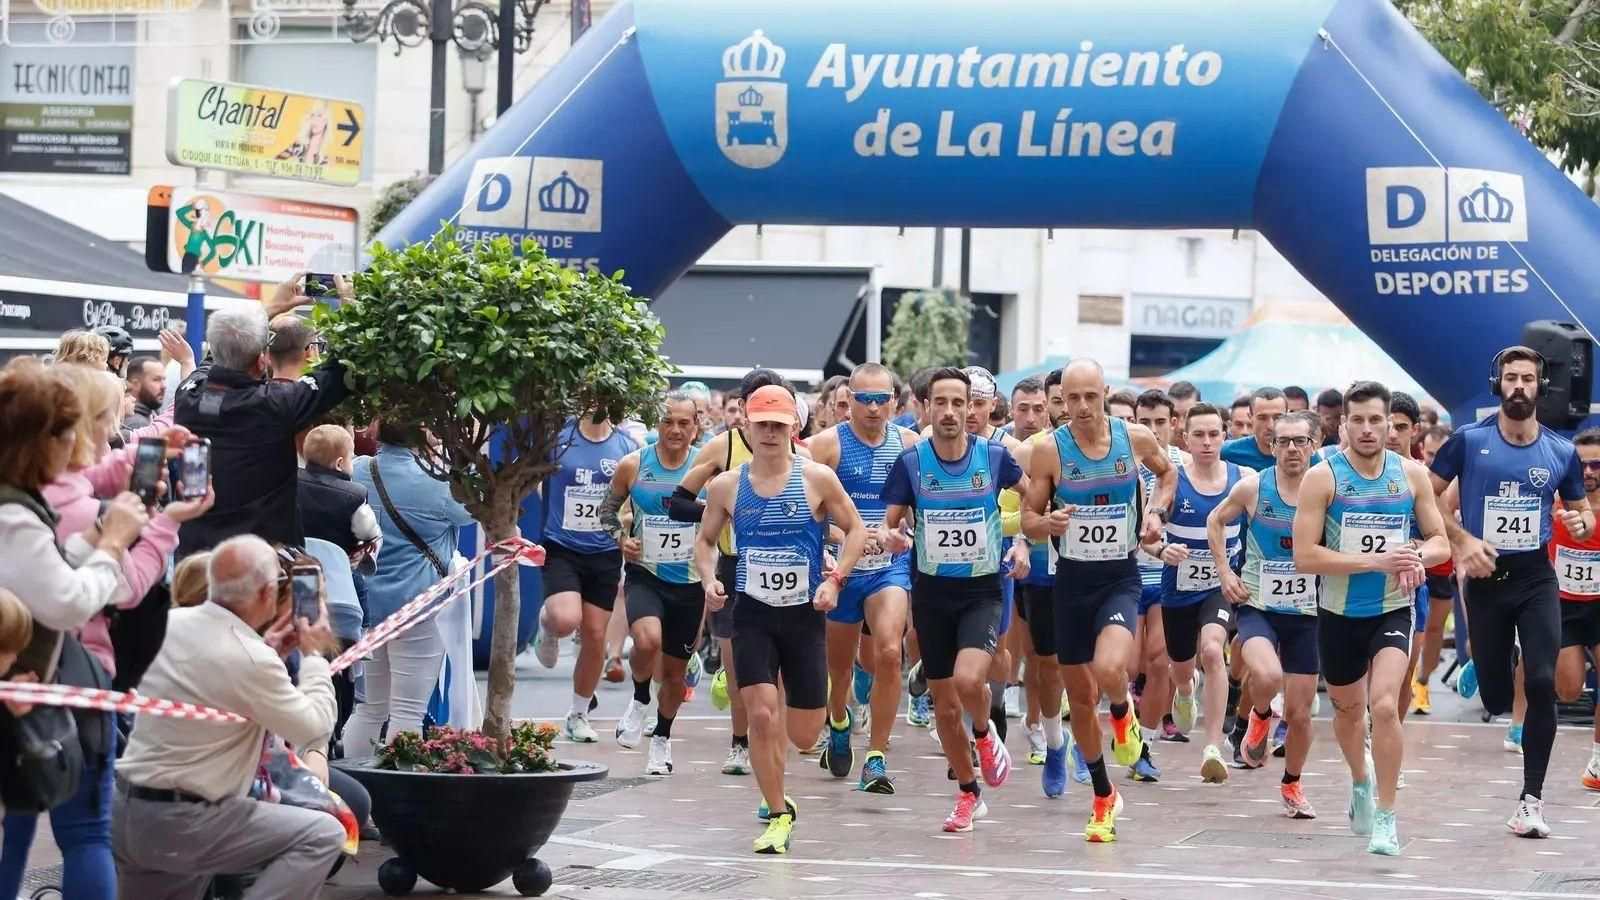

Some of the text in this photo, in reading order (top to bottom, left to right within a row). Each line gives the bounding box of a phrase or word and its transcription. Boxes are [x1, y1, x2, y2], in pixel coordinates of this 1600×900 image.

[13, 63, 130, 95] TECNICONTA
[806, 40, 1222, 102] Ayuntamiento
[198, 86, 288, 130] Chantal
[17, 133, 68, 143] SERVICIOS
[853, 107, 1178, 157] de La Línea
[477, 173, 511, 212] D
[1386, 185, 1426, 229] D
[455, 231, 573, 248] DELEGCIN DE
[1370, 244, 1499, 262] DELEGACIÓN DE
[1374, 269, 1529, 296] DEPORTES
[1144, 304, 1234, 328] NAGAR
[574, 503, 599, 518] 32
[1078, 525, 1118, 543] 202
[1496, 517, 1531, 534] 241
[658, 533, 682, 549] 75
[937, 529, 977, 547] 230
[1360, 535, 1387, 553] 92
[759, 571, 798, 591] 199
[1564, 564, 1594, 581] 131
[1271, 578, 1307, 595] 213
